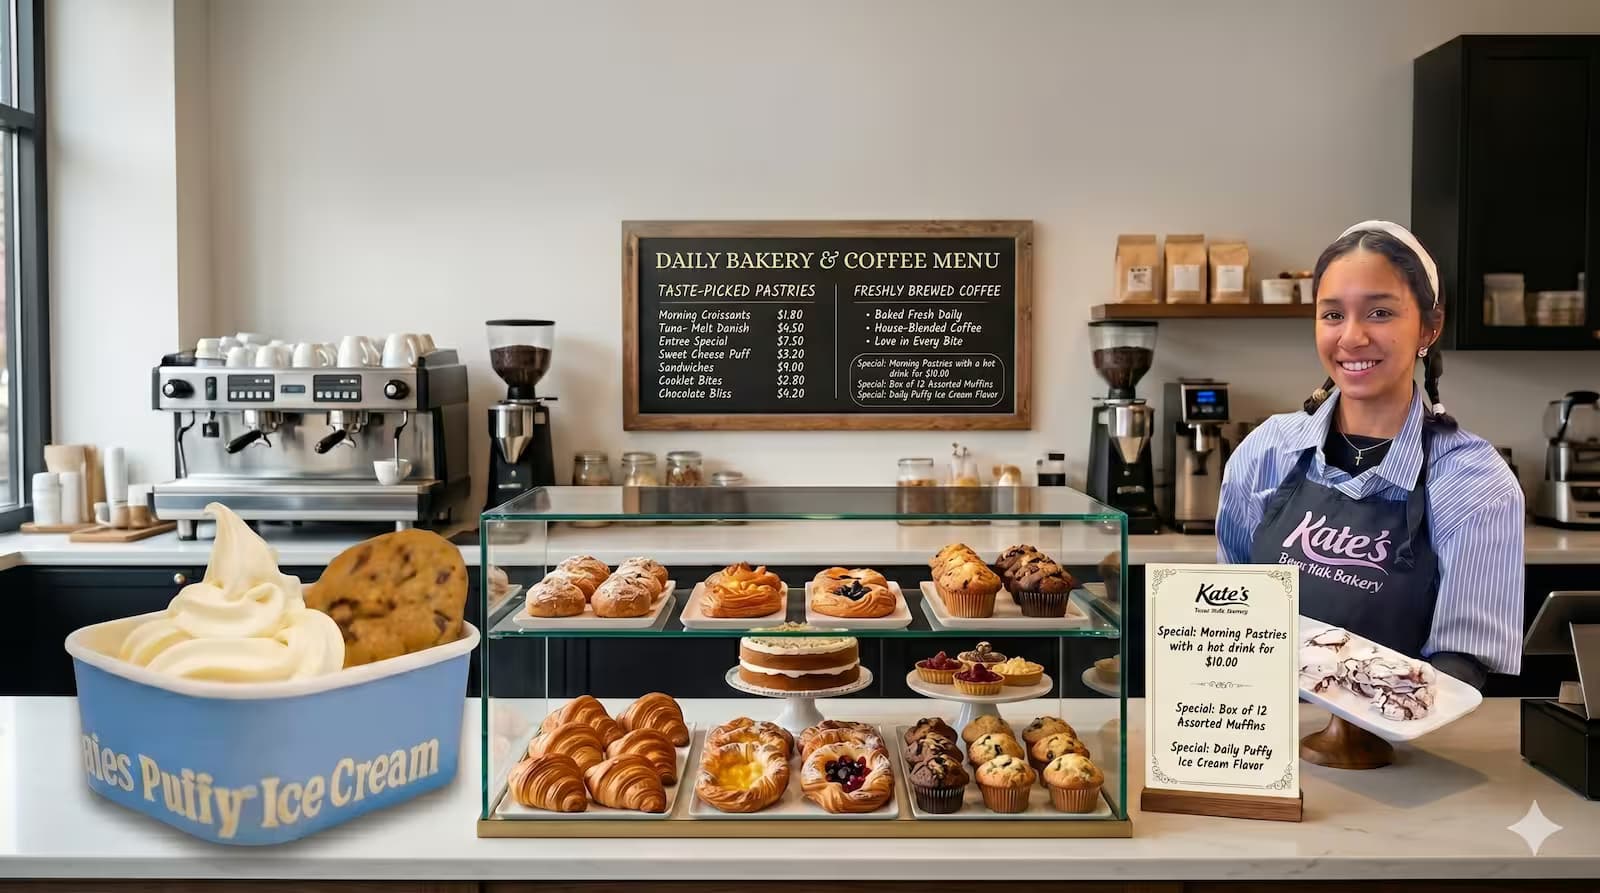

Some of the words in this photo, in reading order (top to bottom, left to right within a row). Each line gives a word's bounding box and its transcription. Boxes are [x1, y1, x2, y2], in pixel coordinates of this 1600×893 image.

[656, 252, 721, 269] DAILY
[726, 252, 814, 269] BAKERY
[819, 251, 839, 269] &
[844, 252, 927, 269] COFFEE
[933, 252, 1000, 269] MENU
[658, 284, 750, 297] TASTE-PICKED
[755, 284, 816, 297] PASTRIES
[854, 285, 904, 296] FRESHLY
[908, 285, 954, 296] BREWED
[959, 285, 1001, 296] COFFEE
[659, 310, 697, 322] Morning
[701, 310, 751, 320] Croissants
[777, 309, 803, 320] $1.80
[875, 309, 904, 319] Baked
[908, 309, 934, 319] Fresh
[939, 309, 962, 322] Daily
[659, 323, 688, 333] Tuna-
[691, 323, 713, 333] Melt
[717, 323, 749, 333] Danish
[777, 322, 804, 333] $4.50
[875, 323, 946, 333] House-Blended
[950, 322, 982, 333] Coffee
[659, 336, 690, 346] Entree
[693, 336, 728, 351] Special
[777, 335, 804, 346] $7.50
[875, 336, 896, 346] Love
[900, 336, 909, 346] in
[914, 336, 940, 348] Every
[944, 336, 963, 346] Bite
[658, 349, 687, 359] Sweet
[691, 349, 724, 359] Cheese
[729, 348, 751, 359] Puff
[777, 348, 804, 359] $3.20
[658, 362, 714, 372] Sandwiches
[777, 362, 804, 372] $9.00
[857, 359, 886, 369] Special:
[889, 359, 919, 369] Morning
[922, 359, 952, 367] Pastries
[955, 359, 972, 367] with
[983, 359, 996, 367] hot
[889, 369, 908, 378] drink
[912, 369, 922, 378] for
[925, 369, 949, 378] $10.00
[659, 375, 694, 386] Cooklet
[698, 375, 722, 386] Bites
[777, 375, 804, 386] $2.80
[857, 380, 886, 390] Special:
[889, 380, 903, 388] Box
[906, 380, 914, 388] of
[917, 380, 925, 388] 12
[928, 380, 961, 388] Assorted
[964, 380, 993, 388] Muffins
[659, 388, 705, 399] Chocolate
[709, 388, 732, 399] Bliss
[777, 388, 804, 399] $4.20
[857, 390, 886, 401] Special:
[889, 390, 908, 401] Daily
[911, 390, 932, 401] Puffy
[975, 390, 998, 398] Flavor
[1282, 510, 1391, 563] Kate's
[1334, 569, 1383, 593] Bakery
[1195, 583, 1249, 607] Kate's
[1157, 626, 1197, 639] Special:
[1200, 627, 1241, 641] Morning
[1245, 628, 1287, 640] Pastries
[1170, 642, 1193, 651] with
[1207, 642, 1224, 652] hot
[1229, 643, 1255, 653] drink
[1259, 644, 1275, 654] for
[1205, 656, 1238, 668] $10.00
[1176, 702, 1215, 714] Special:
[1219, 704, 1237, 714] Box
[1241, 705, 1253, 715] of
[1257, 706, 1267, 716] 12
[1177, 719, 1222, 729] Assorted
[1226, 720, 1265, 731] Muffins
[1170, 741, 1210, 754] Special:
[1214, 744, 1240, 757] Daily
[1244, 746, 1273, 760] Puffy
[1178, 757, 1193, 767] Ice
[1197, 758, 1229, 769] Cream
[1233, 759, 1264, 771] Flavor
[260, 777, 325, 828] Ice
[330, 738, 439, 807] Cream
